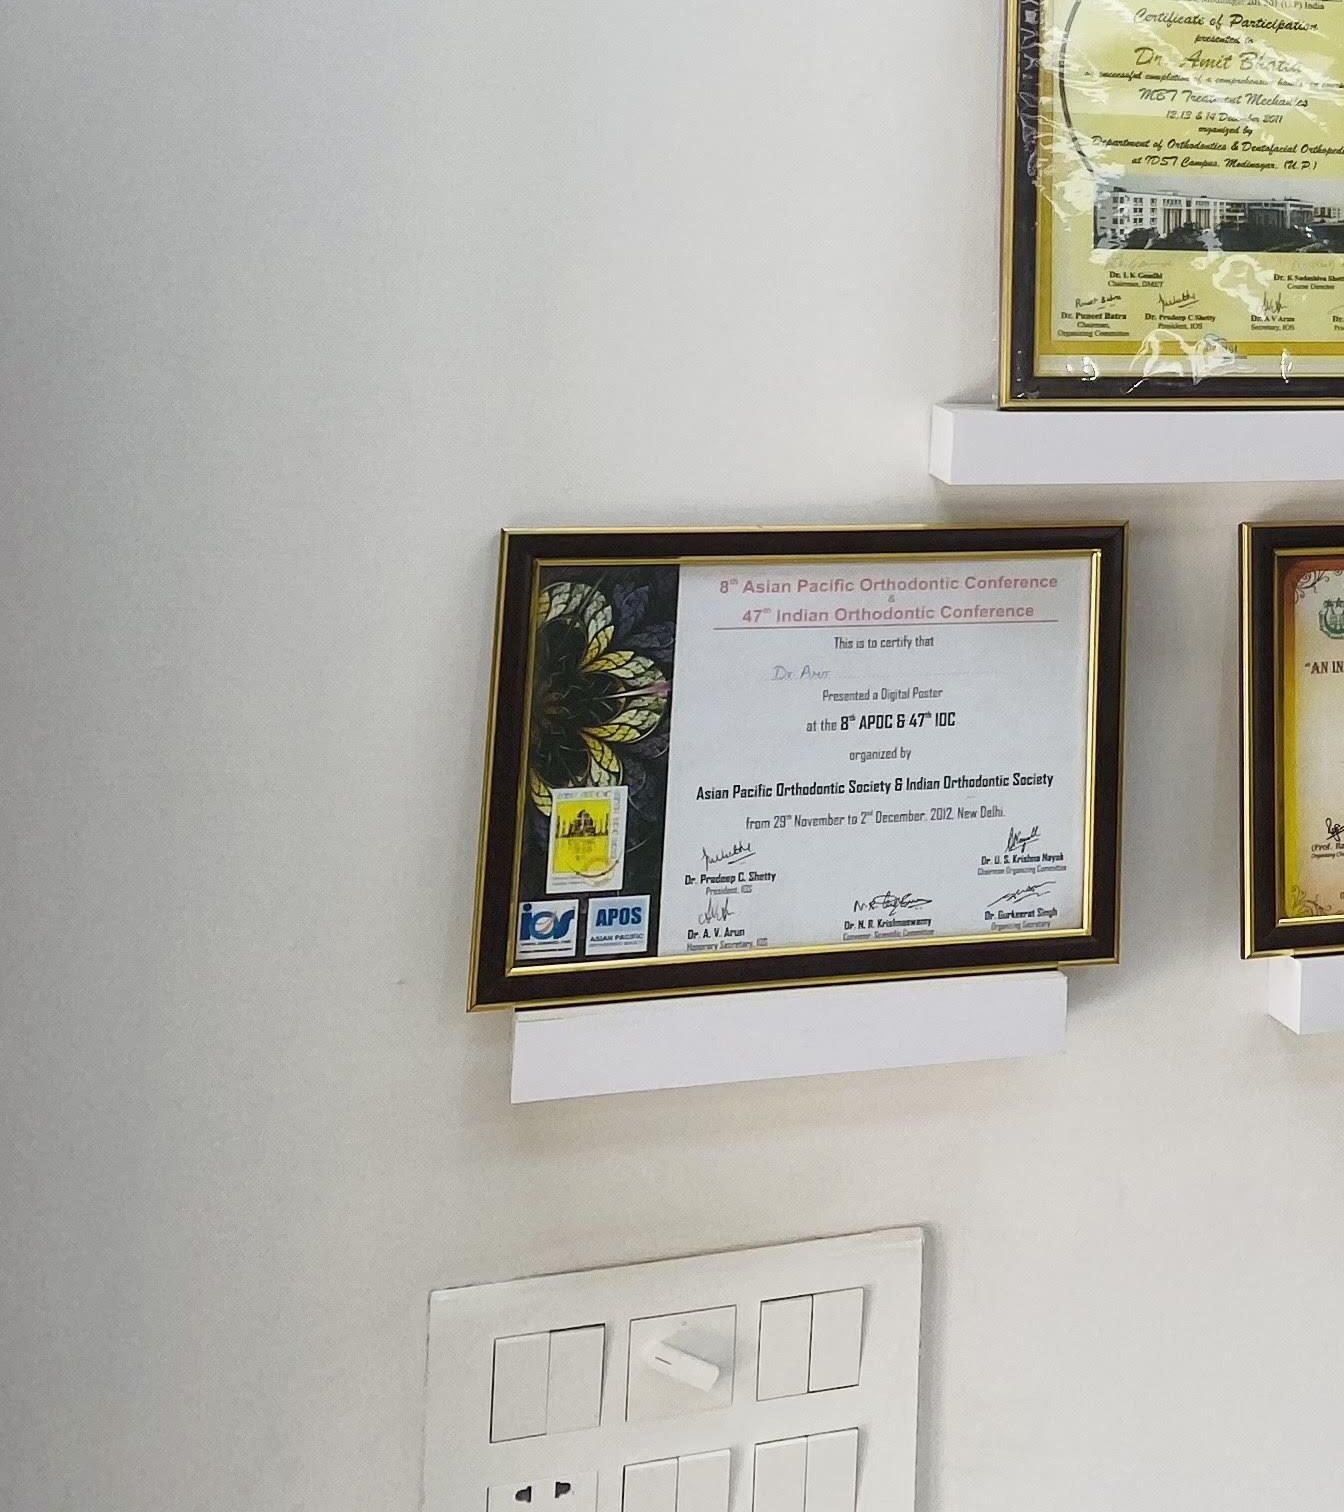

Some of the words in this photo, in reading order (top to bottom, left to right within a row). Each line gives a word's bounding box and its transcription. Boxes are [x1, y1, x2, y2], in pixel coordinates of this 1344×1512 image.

[1134, 8, 1205, 26] Certificate
[1209, 15, 1223, 31] of
[1091, 136, 1151, 150] Department
[1152, 138, 1164, 152] of
[1167, 138, 1227, 152] Orthodontics
[1231, 141, 1239, 152] &
[1242, 141, 1298, 156] Dentofacial
[720, 578, 738, 593] 8th
[743, 579, 791, 593] Asian
[798, 579, 854, 593] Pacific
[860, 577, 959, 591] Orthodontic
[965, 576, 1058, 590] Conference
[776, 607, 828, 623] Indian
[835, 605, 934, 621] Orthodontic
[940, 604, 1034, 619] Conference
[806, 721, 817, 732] at
[819, 719, 836, 732] the
[859, 714, 893, 730] APOC
[897, 714, 905, 729] &
[935, 712, 956, 727] IOC
[696, 785, 729, 800] Asian
[733, 784, 773, 799] Pacific
[776, 781, 845, 797] Orthodontic
[848, 780, 891, 795] Society
[895, 778, 903, 791] &
[906, 777, 940, 791] Indian
[943, 774, 1010, 789] Orthodontic
[1013, 773, 1053, 788] Society
[595, 907, 642, 926] APOS
